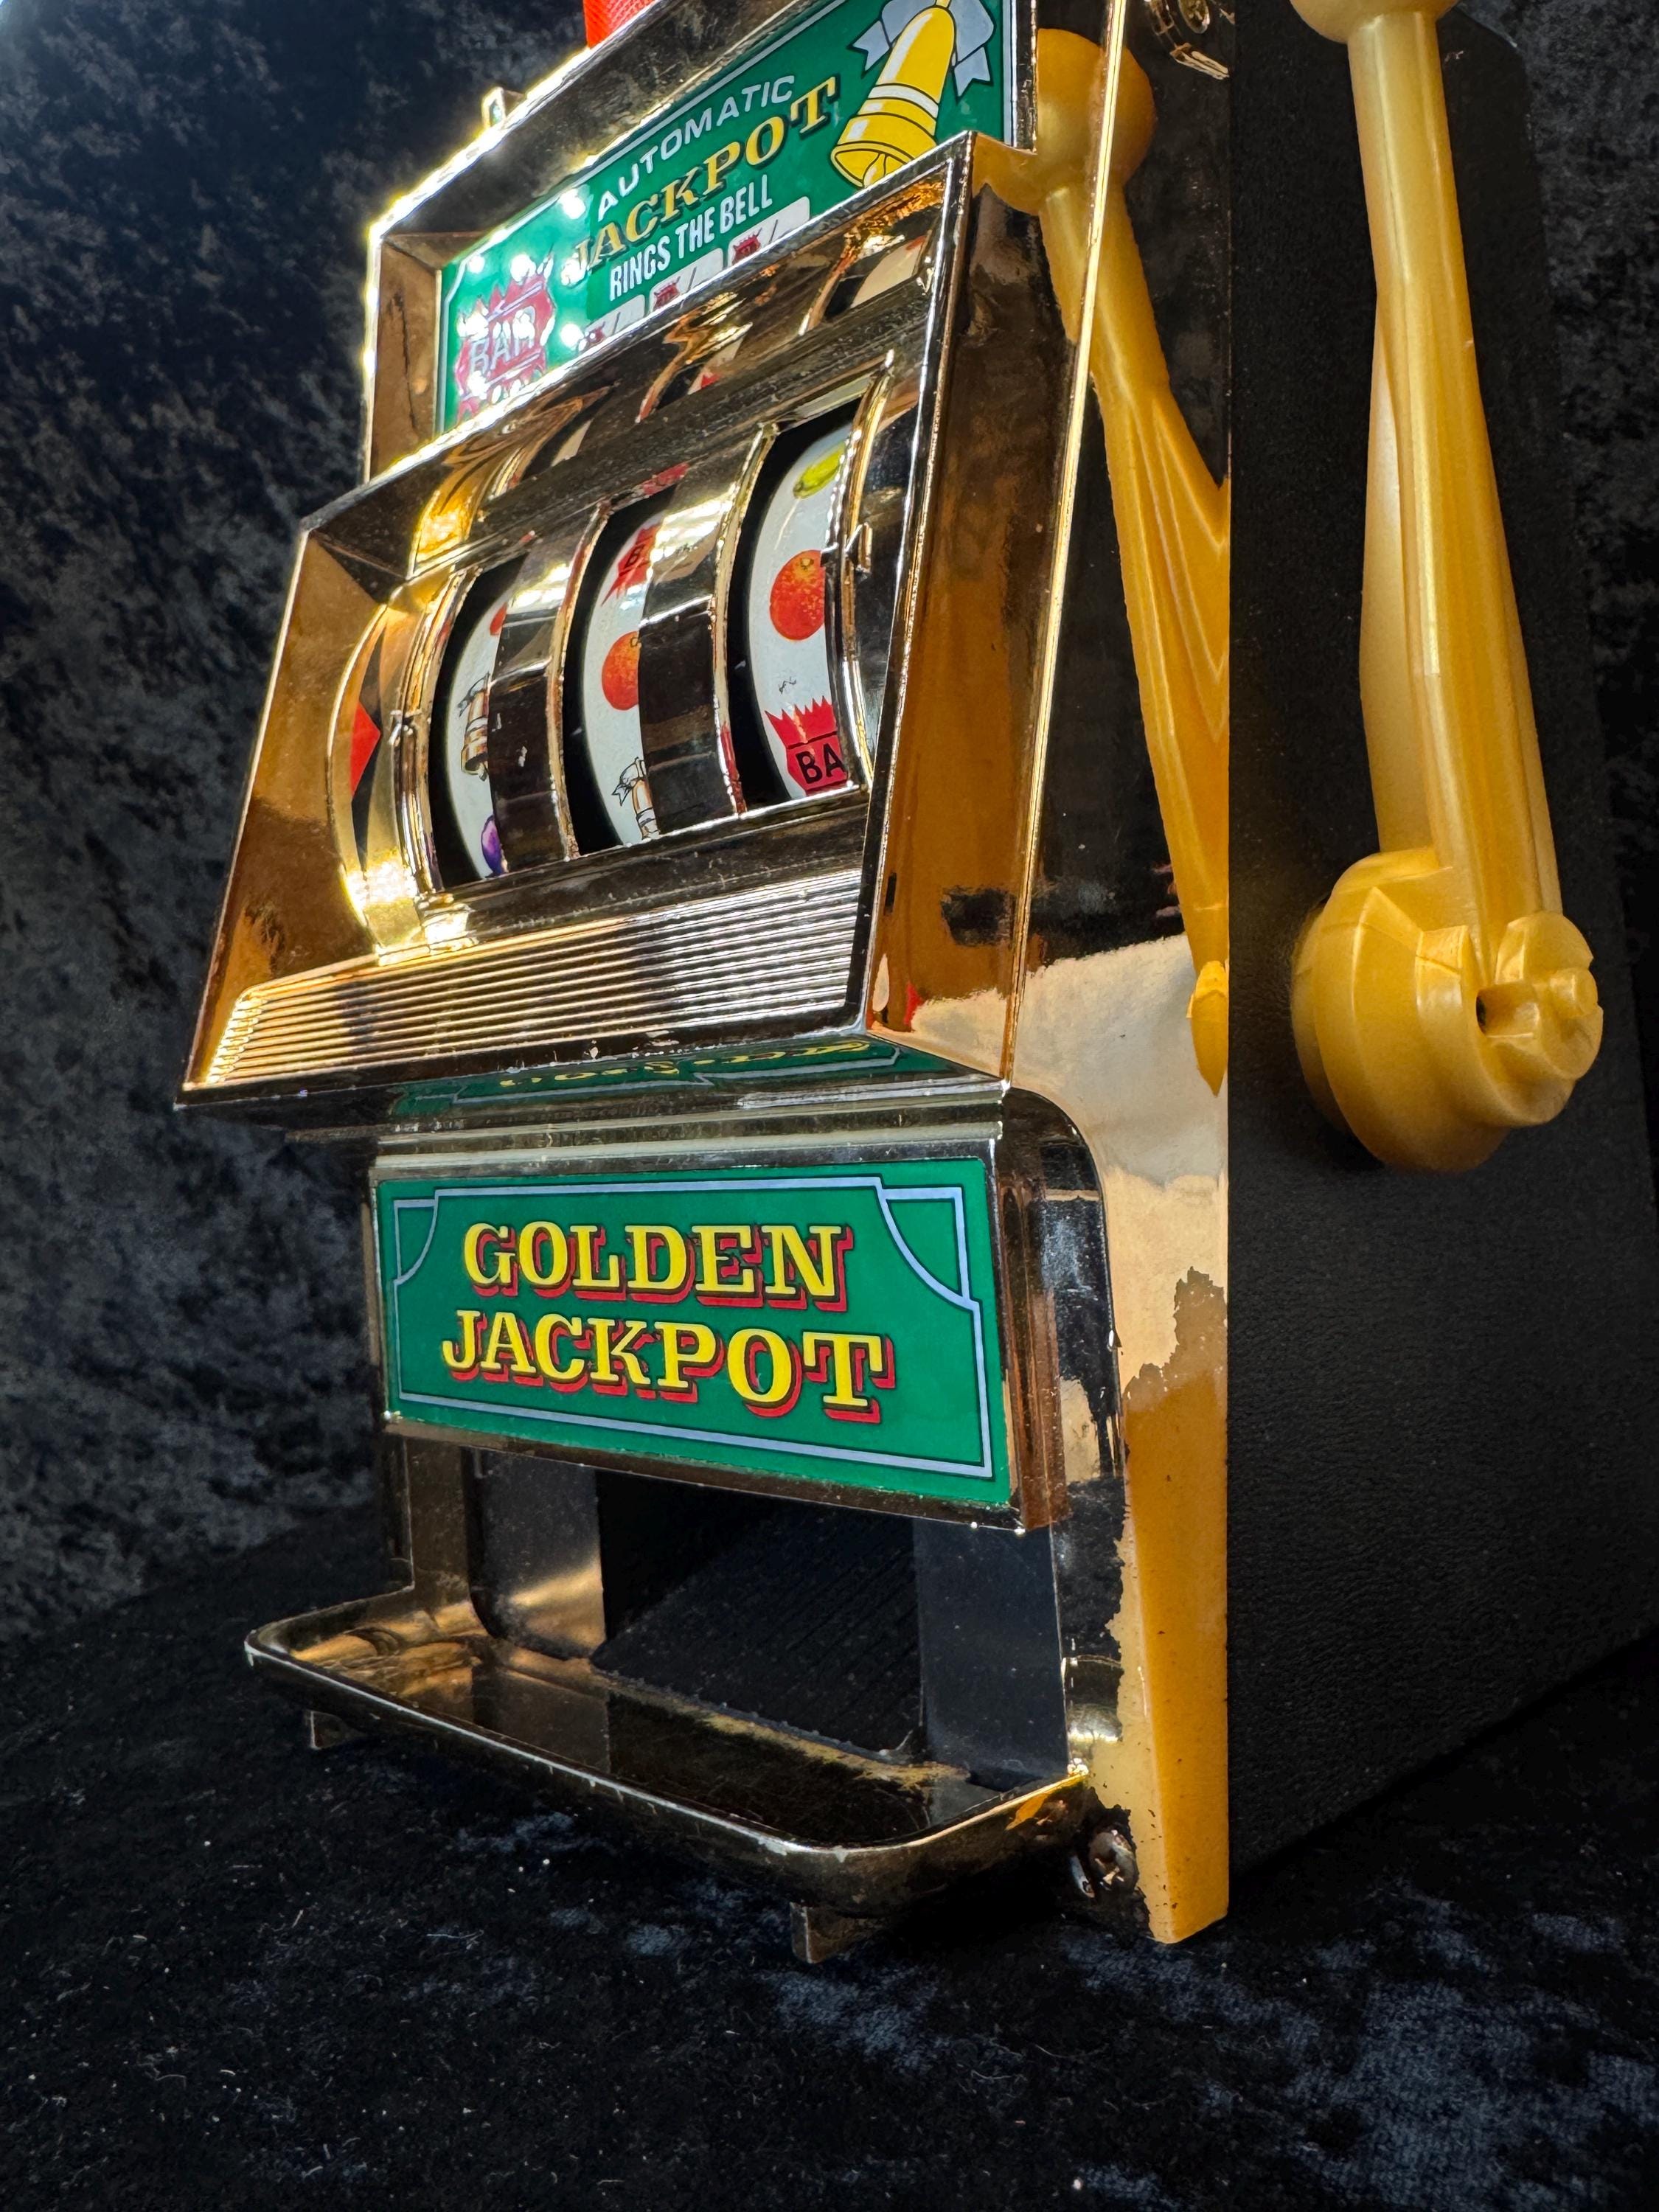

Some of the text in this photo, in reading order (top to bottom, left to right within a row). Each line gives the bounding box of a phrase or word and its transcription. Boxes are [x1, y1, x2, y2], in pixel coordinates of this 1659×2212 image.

[563, 74, 839, 288] JACKPOT
[598, 74, 795, 221] AUTOMATIC
[609, 174, 773, 302] RINGS THE BELL
[462, 1221, 852, 1312] GOLDEN
[442, 1310, 896, 1424] JACKPOT
